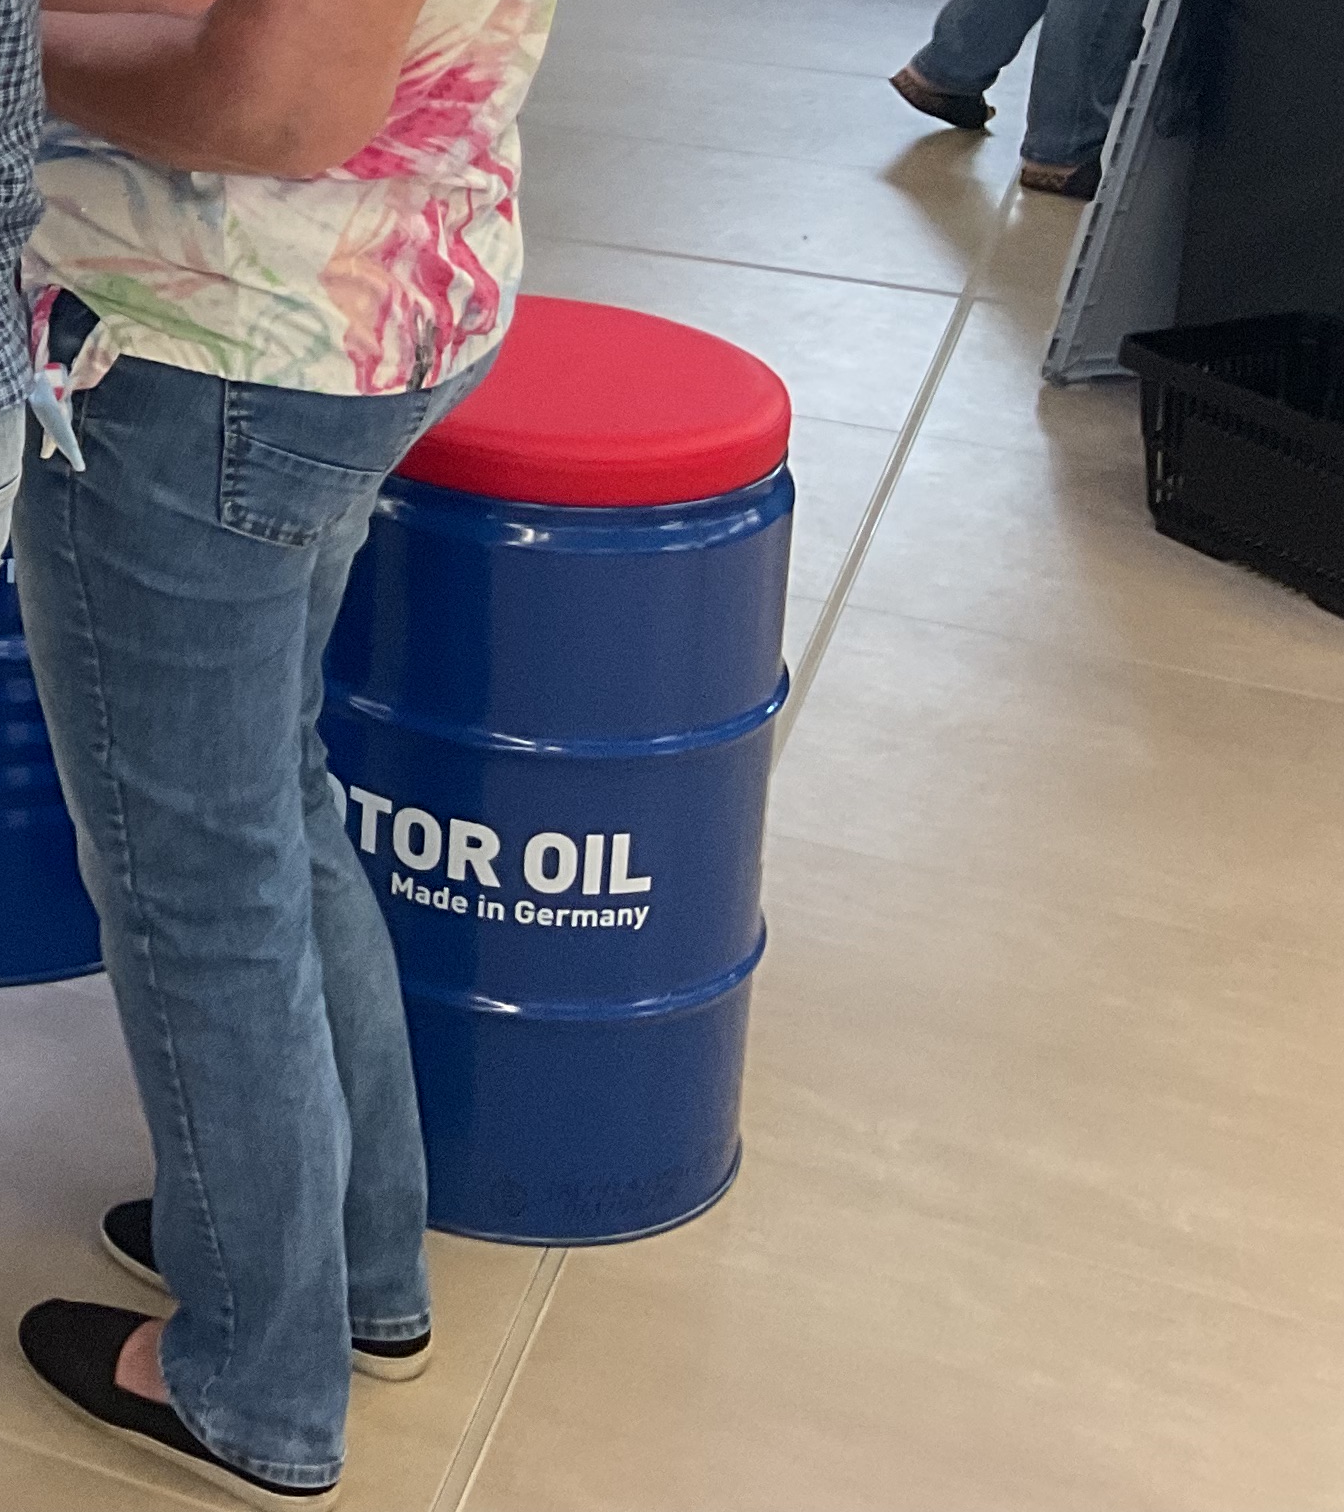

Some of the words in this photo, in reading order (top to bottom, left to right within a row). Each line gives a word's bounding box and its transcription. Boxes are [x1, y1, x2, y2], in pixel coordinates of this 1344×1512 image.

[523, 832, 652, 896] OIL
[391, 872, 468, 915] Made
[477, 895, 504, 921] in
[514, 901, 650, 930] Germany
